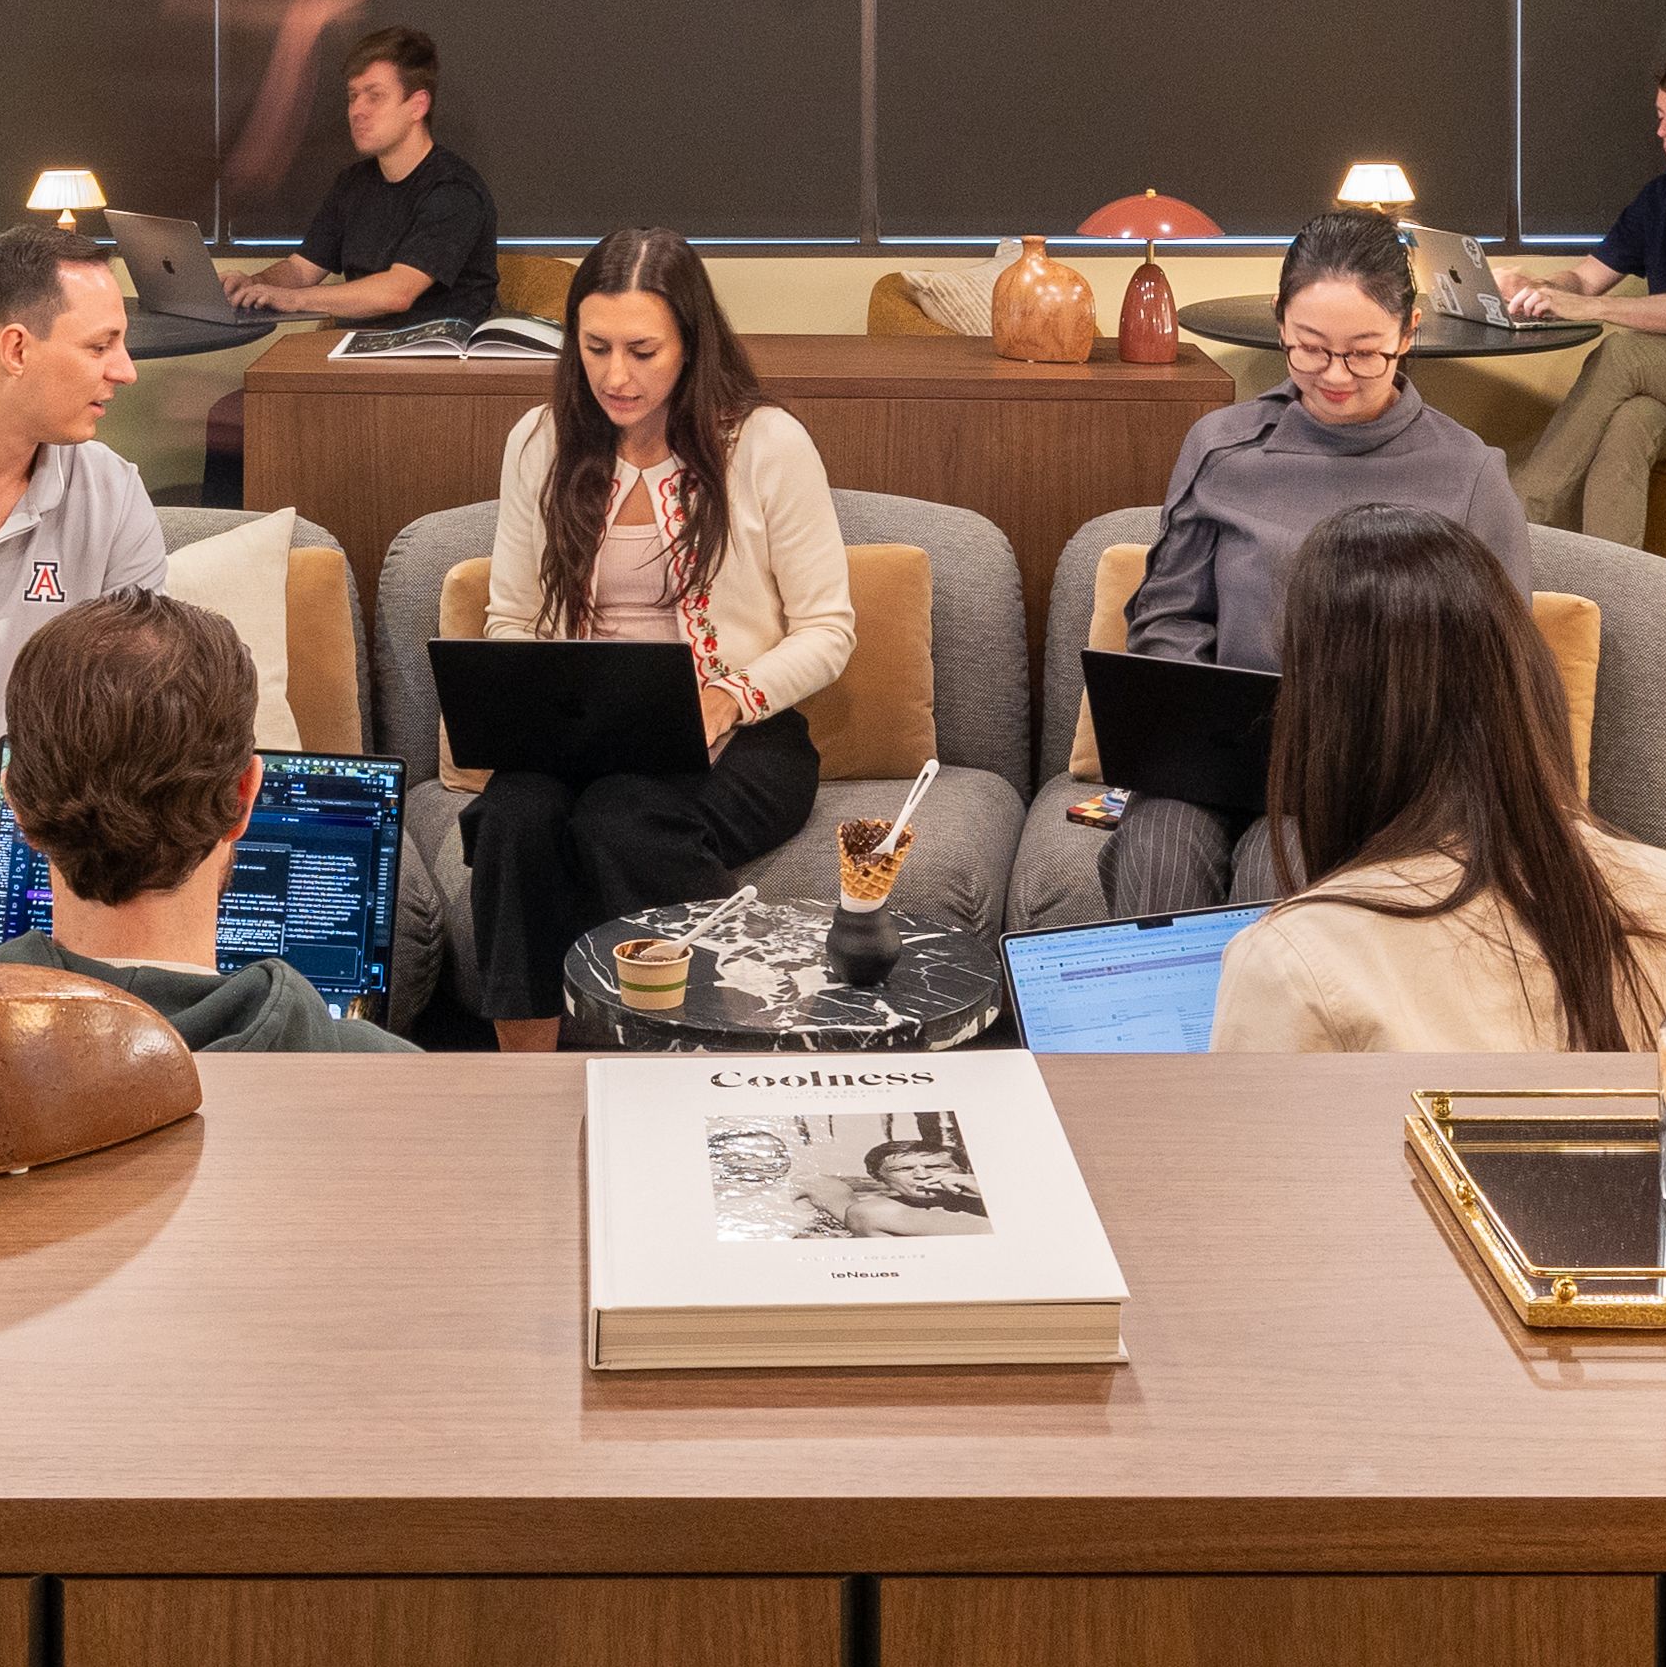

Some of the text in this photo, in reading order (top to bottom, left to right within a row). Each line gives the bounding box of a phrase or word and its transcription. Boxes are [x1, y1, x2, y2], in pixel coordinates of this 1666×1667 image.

[23, 561, 66, 603] A
[709, 1070, 935, 1088] Coolness
[831, 1271, 900, 1279] teNeues
